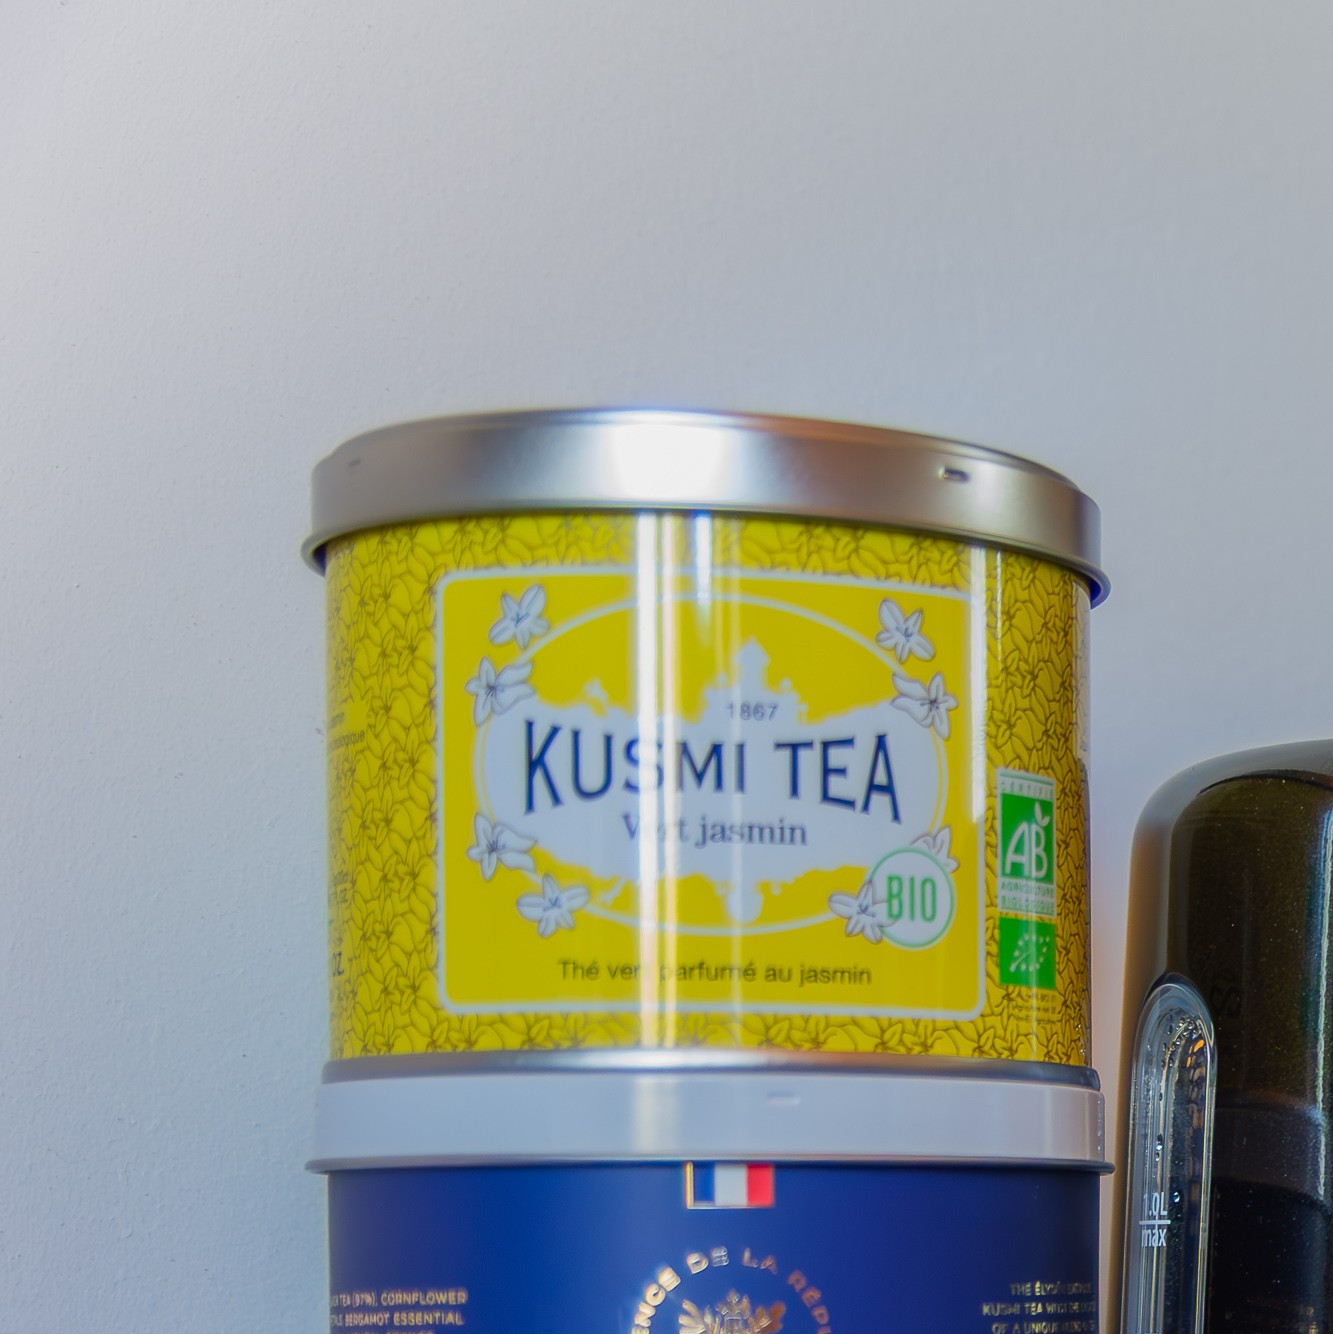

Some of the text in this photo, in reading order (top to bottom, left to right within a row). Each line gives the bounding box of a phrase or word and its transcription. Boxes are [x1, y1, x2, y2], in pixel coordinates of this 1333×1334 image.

[727, 701, 779, 721] 1867
[523, 719, 902, 825] KUSMI TEA
[695, 814, 808, 848] jasmin
[1004, 819, 1048, 880] AB
[886, 873, 937, 923] BIO
[558, 958, 600, 981] Thé
[764, 963, 792, 983] au
[799, 961, 872, 987] jasmin
[1141, 1228, 1167, 1248] max
[686, 1245, 730, 1274] DE
[741, 1246, 778, 1275] LA
[380, 1289, 468, 1307] CORNFLOWER
[393, 1311, 464, 1326] ESSENTIAL
